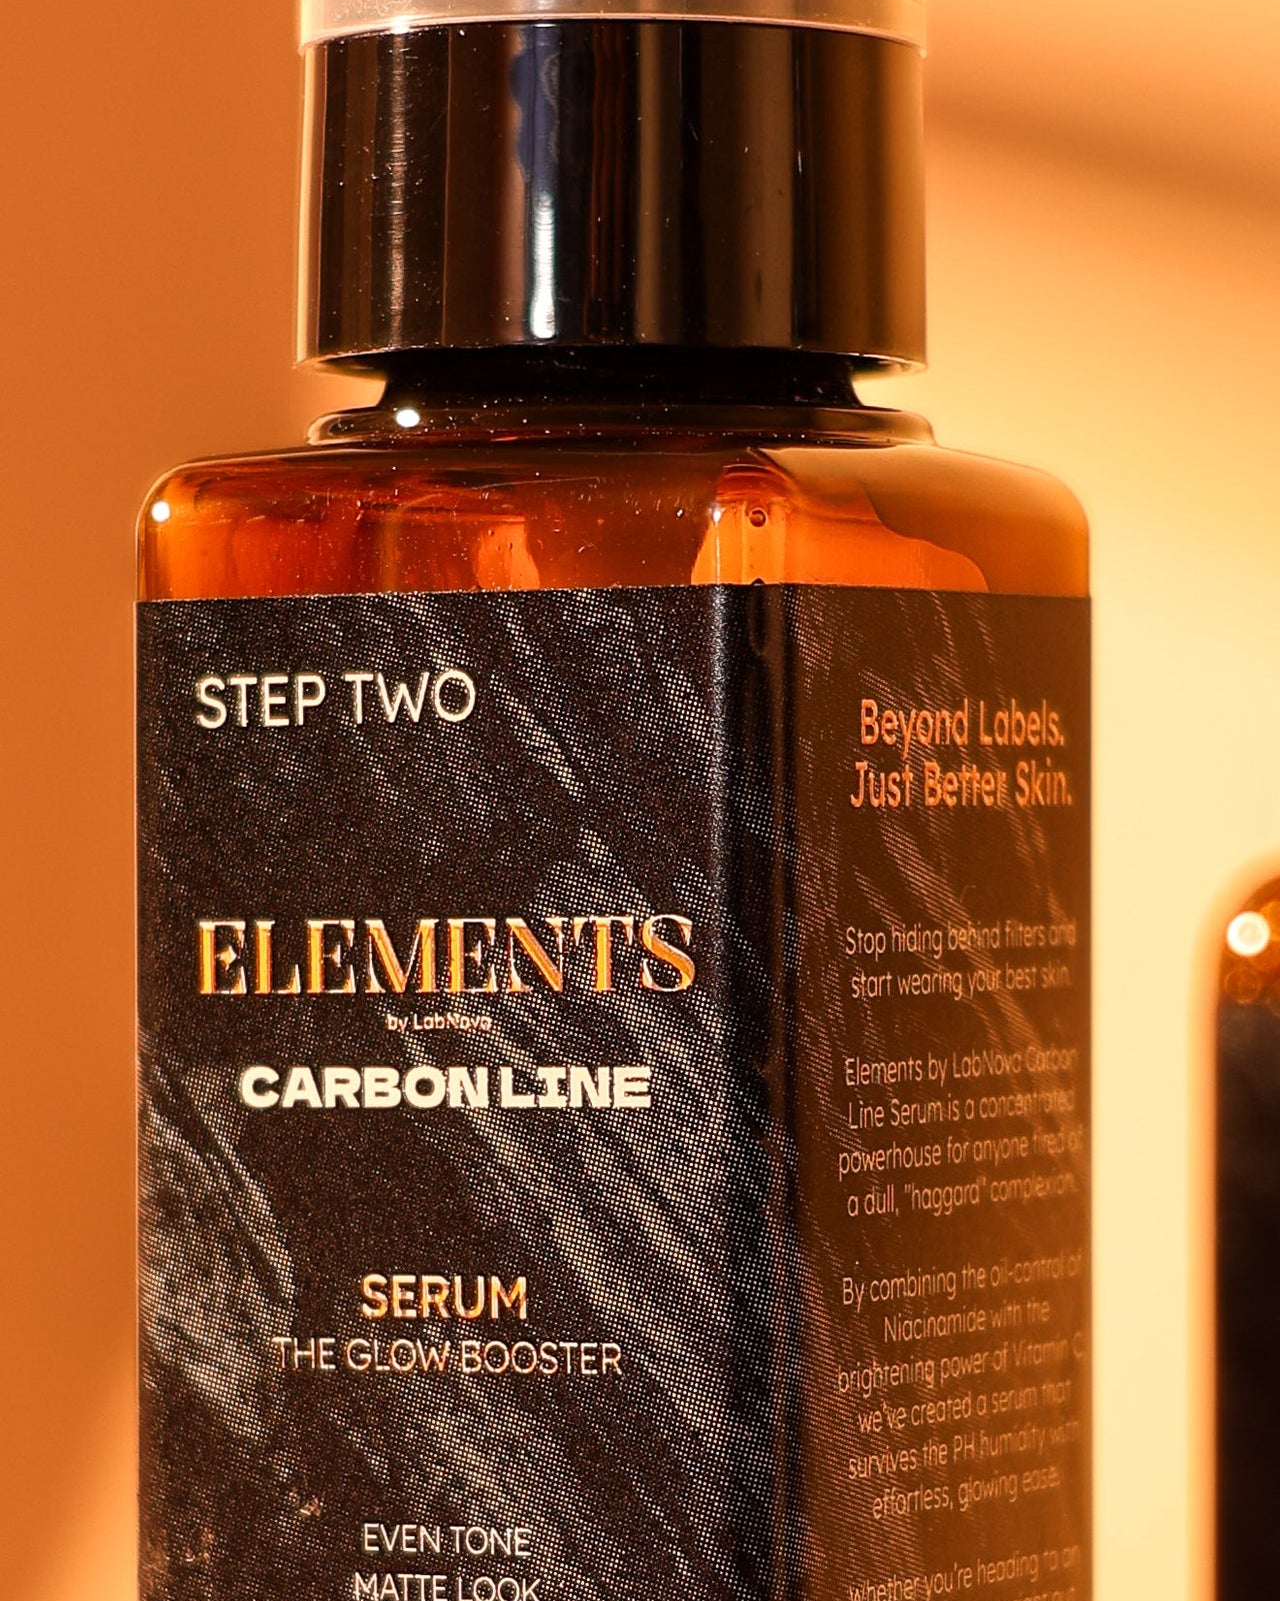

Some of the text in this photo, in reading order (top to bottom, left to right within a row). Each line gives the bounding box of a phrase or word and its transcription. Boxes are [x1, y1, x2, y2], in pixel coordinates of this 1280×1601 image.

[195, 669, 476, 729] STEP TWO
[860, 699, 1065, 760] Beyond Labels.
[850, 757, 1073, 808] Just Better Skin.
[199, 914, 695, 995] ELEMENTS
[845, 926, 886, 962] Stop
[891, 924, 943, 959] hiding
[948, 921, 1000, 950] behind
[1005, 920, 1045, 949] filters
[852, 970, 891, 1000] start
[898, 967, 962, 1001] wearing
[968, 969, 1002, 997] your
[1005, 963, 1038, 990] best
[387, 1012, 492, 1033] by LabNova
[241, 1065, 652, 1109] CARBON LINE
[844, 1057, 923, 1087] Elements
[929, 1052, 948, 1087] by
[952, 1051, 1022, 1078] LabNova
[848, 1102, 884, 1130] Line
[890, 1100, 944, 1125] Serum
[948, 1094, 959, 1120] is
[965, 1100, 975, 1119] a
[838, 1140, 941, 1182] powerhouse
[947, 1134, 968, 1164] for
[973, 1137, 1028, 1167] anyone
[847, 1196, 859, 1217] a
[864, 1184, 899, 1216] dull,
[905, 1178, 987, 1216] "haggard"
[361, 1274, 527, 1320] SERUM
[842, 1276, 866, 1312] By
[870, 1269, 957, 1301] combining
[962, 1266, 987, 1292] the
[884, 1298, 1050, 1343] Niacinamide with the
[275, 1338, 622, 1376] THE GLOW BOOSTER
[838, 1356, 935, 1397] brightening
[940, 1354, 990, 1383] power
[993, 1345, 1009, 1369] of
[1013, 1339, 1068, 1367] Vitamin
[858, 1402, 907, 1434] we've
[911, 1391, 972, 1423] created
[977, 1395, 987, 1414] a
[991, 1386, 1037, 1410] serum
[848, 1446, 918, 1479] survives
[923, 1439, 948, 1467] the
[953, 1436, 975, 1461] PH
[873, 1484, 953, 1518] effortless,
[958, 1468, 1019, 1512] glowing
[363, 1524, 532, 1556] EVEN TONE
[353, 1573, 447, 1601] MATTE
[977, 1553, 1039, 1588] heading
